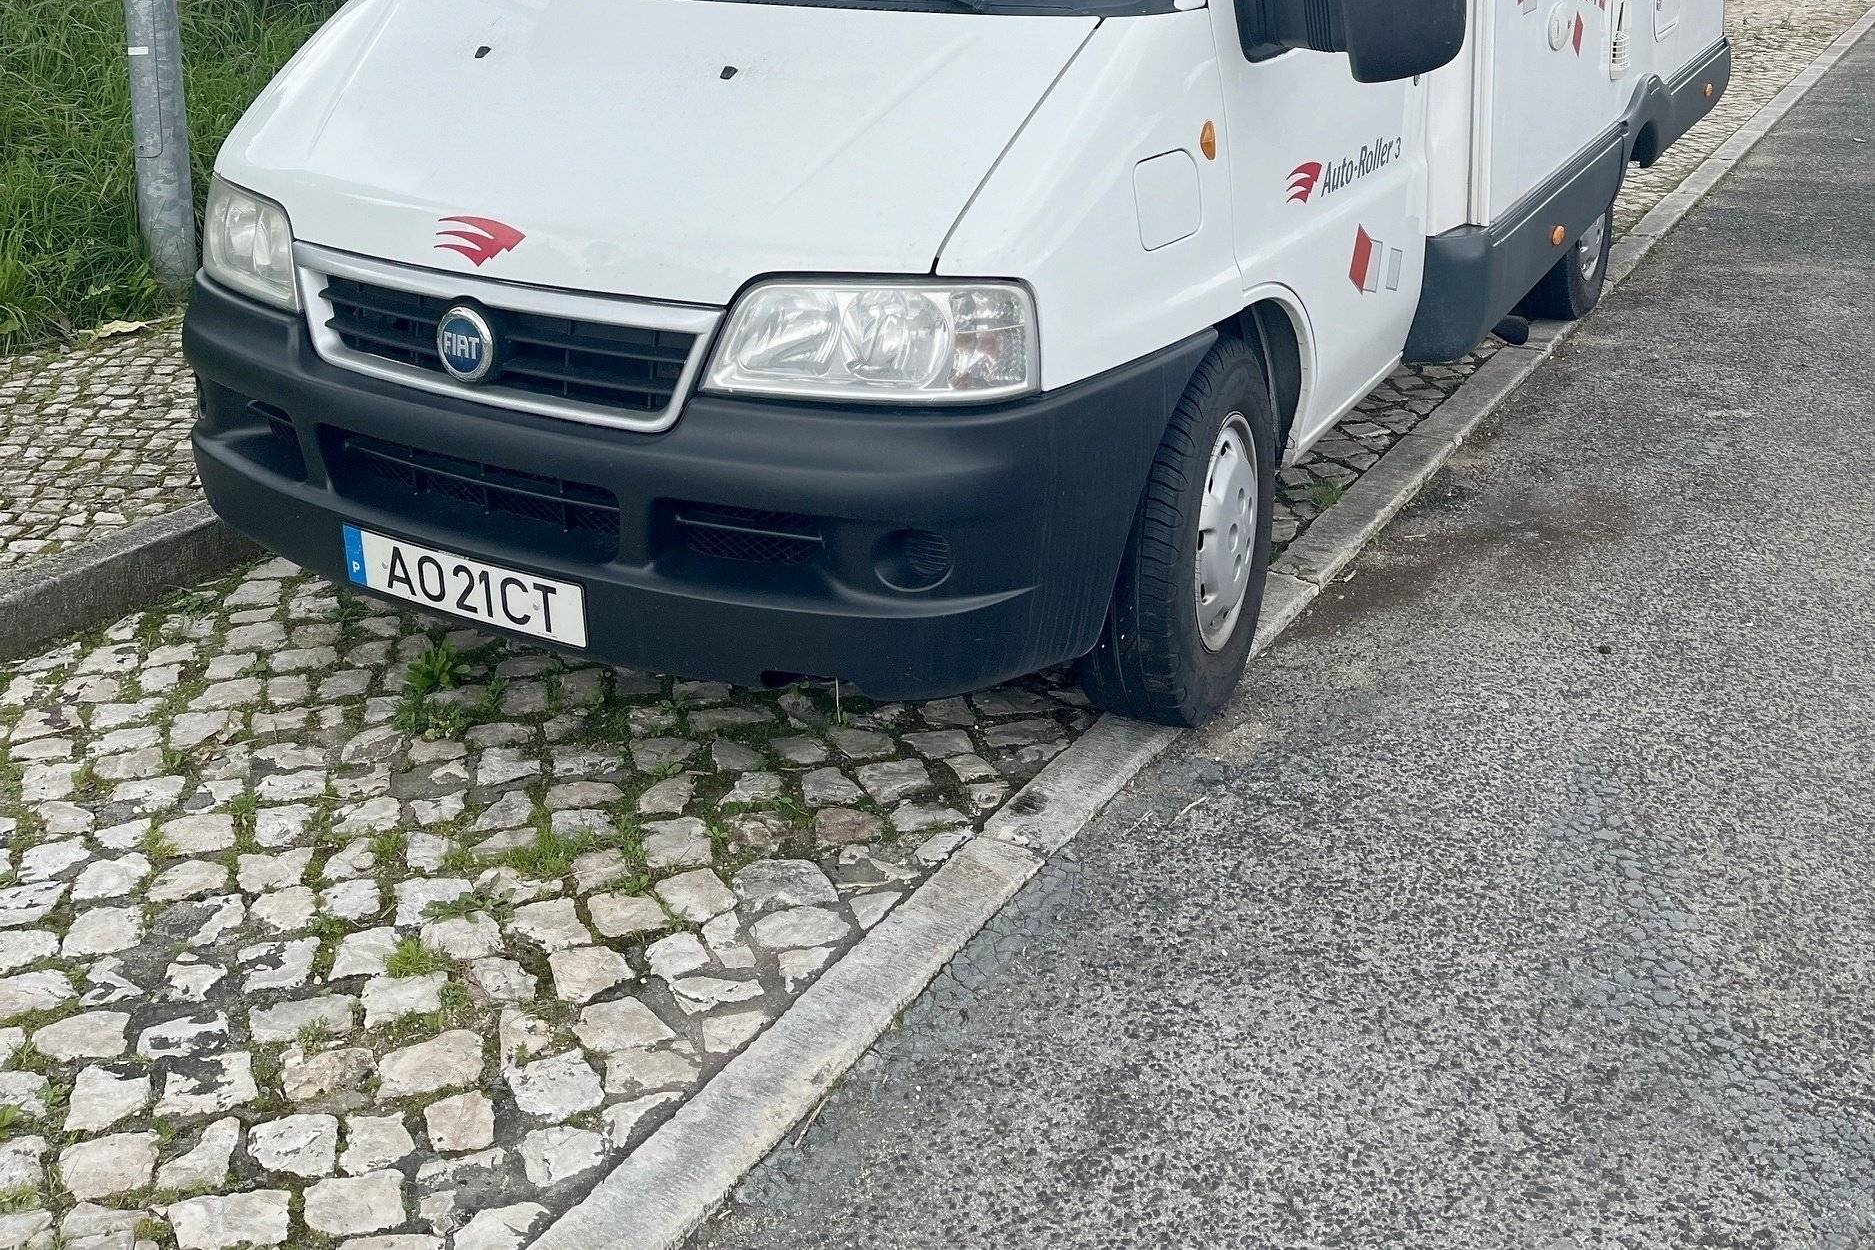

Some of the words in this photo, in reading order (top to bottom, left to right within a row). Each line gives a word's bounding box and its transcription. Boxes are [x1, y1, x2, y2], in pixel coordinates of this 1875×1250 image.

[1320, 136, 1394, 198] Auto-Roller
[1394, 136, 1401, 159] 3
[443, 331, 480, 360] FIAT
[352, 561, 361, 574] P
